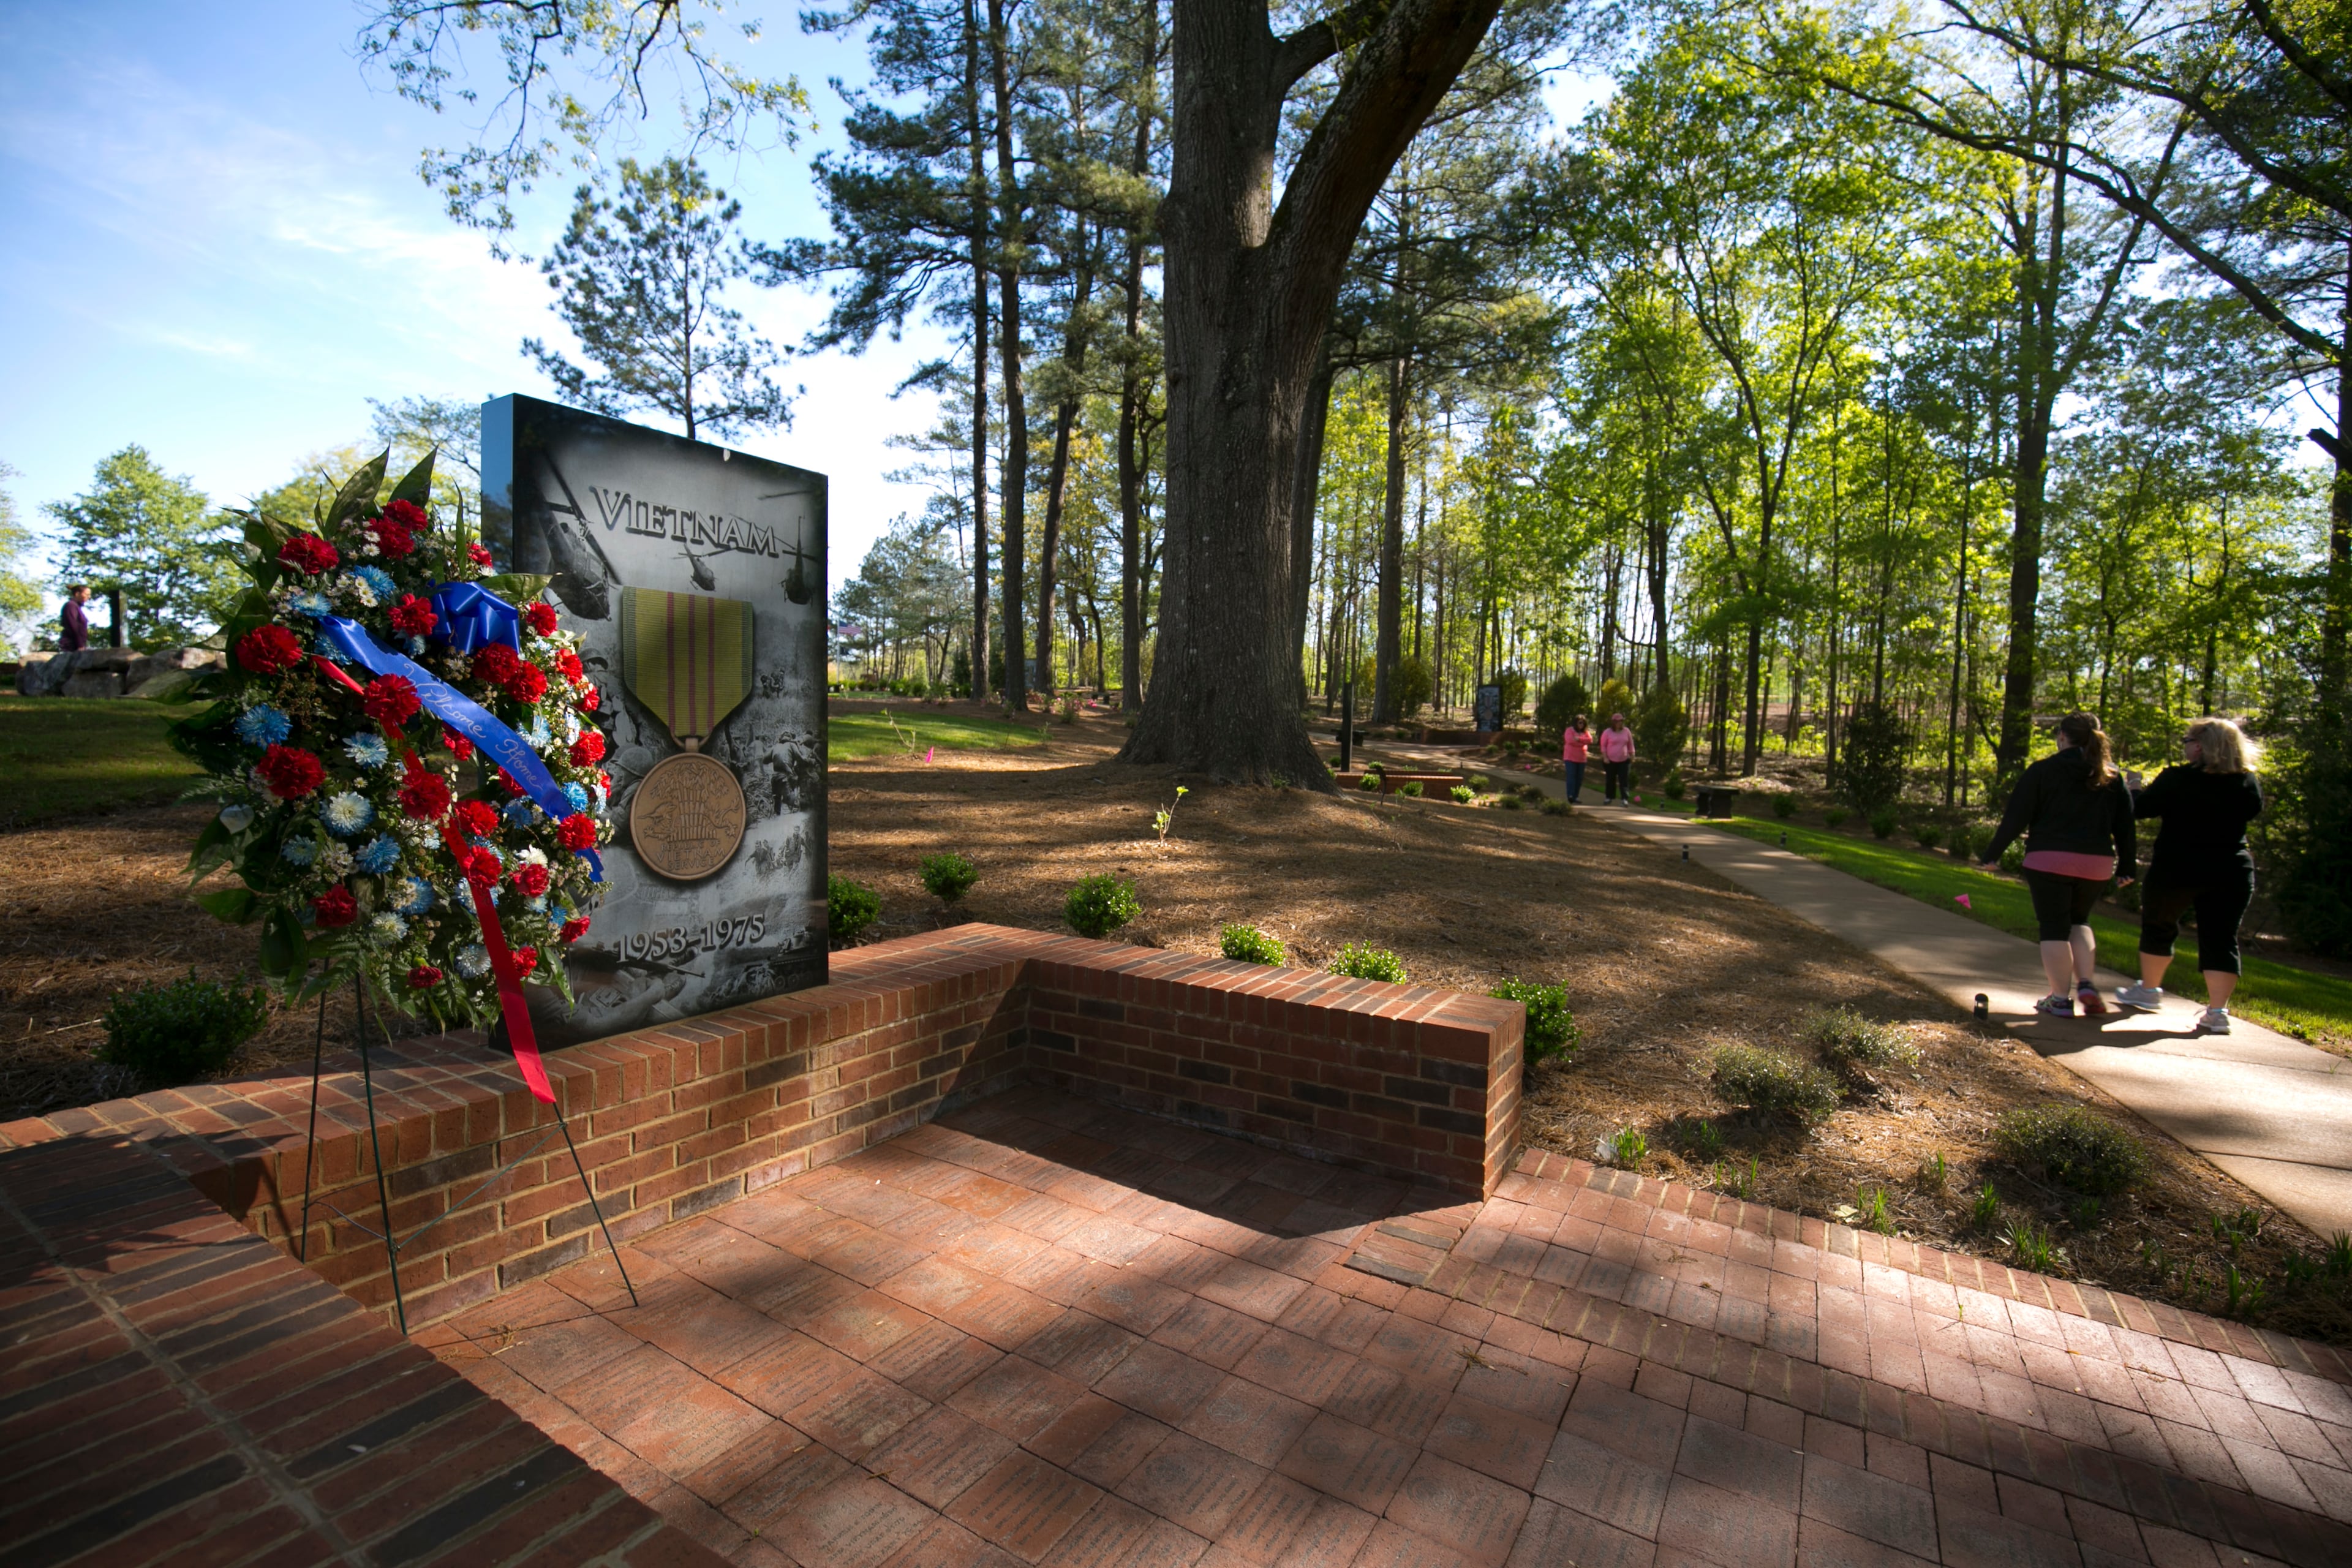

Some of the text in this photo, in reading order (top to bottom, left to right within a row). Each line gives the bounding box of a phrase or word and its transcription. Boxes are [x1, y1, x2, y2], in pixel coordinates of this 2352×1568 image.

[589, 485, 778, 558] VIETNAM
[495, 739, 543, 791] Home
[656, 848, 726, 863] VIETNAM
[662, 841, 704, 852] REPUBLIC
[668, 858, 714, 870] SERVICE
[613, 913, 764, 963] 1953-1975
